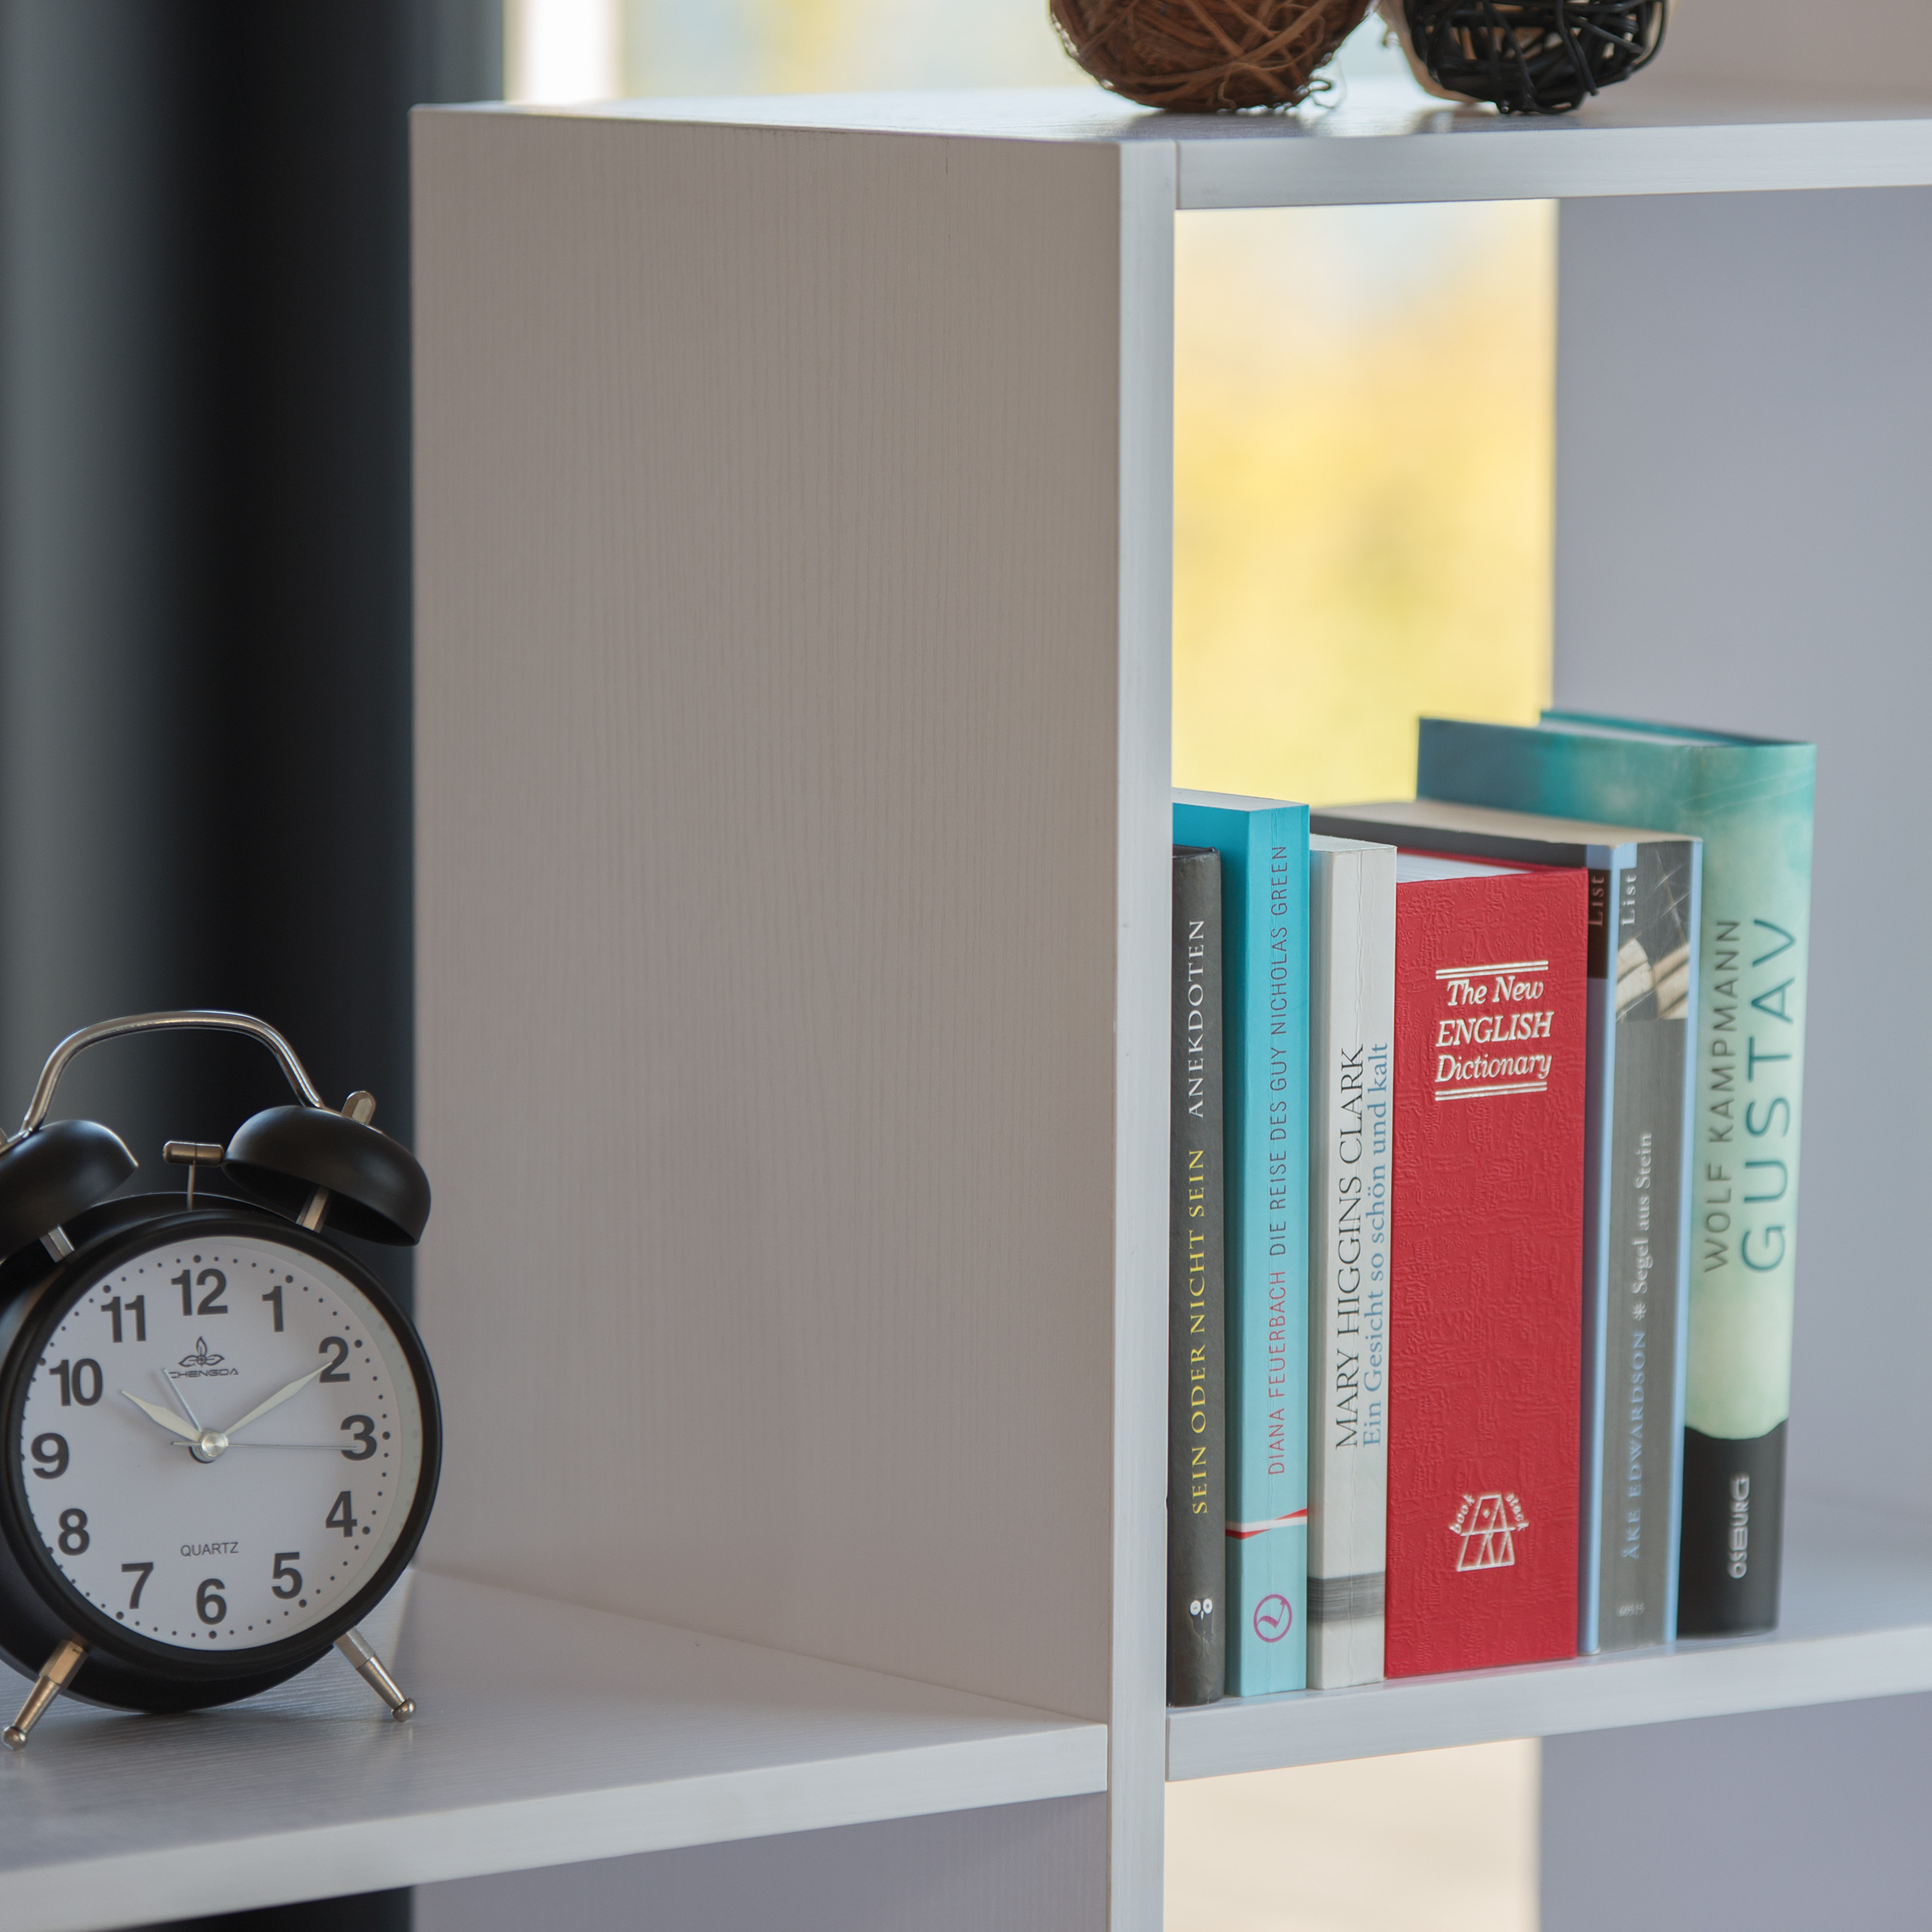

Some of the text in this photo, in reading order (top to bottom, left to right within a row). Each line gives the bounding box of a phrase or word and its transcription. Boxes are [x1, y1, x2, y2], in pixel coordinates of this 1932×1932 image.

[1588, 875, 1604, 927] List
[1620, 875, 1637, 927] List
[1446, 976, 1545, 1007] The New
[1435, 1011, 1554, 1048] ENGLISH
[1435, 1054, 1552, 1084] Dictionary
[1704, 920, 1741, 1273] WOLF KAMPMANN
[1740, 918, 1797, 1272] GUSTAV
[1268, 845, 1287, 1475] DIANA FEUERBACH DIE REISE DES GUY NICHOLAS GREEN
[1188, 920, 1208, 1514] SEIN ODER NICHT SEIN ANEKDOTEN
[1335, 1044, 1364, 1451] MARY HIGGINS CLARK
[1363, 1042, 1389, 1447] Ein Gesicht so schön und kalt
[171, 1268, 228, 1316] 12
[262, 1285, 284, 1333] 1
[100, 1294, 147, 1343] 11
[318, 1336, 350, 1384] 2
[1620, 1133, 1654, 1559] ÅKE EDWARDSON Segel aus Stein
[49, 1358, 103, 1407] 10
[30, 1432, 69, 1480] 9
[340, 1414, 377, 1461] 3
[57, 1508, 91, 1556] 8
[325, 1490, 358, 1538] 4
[1449, 1494, 1530, 1534] book stack
[1728, 1476, 1750, 1579] OSBURG
[180, 1541, 239, 1557] QUARTZ
[121, 1561, 154, 1610] 7
[272, 1551, 303, 1600] 5
[195, 1578, 227, 1626] 6
